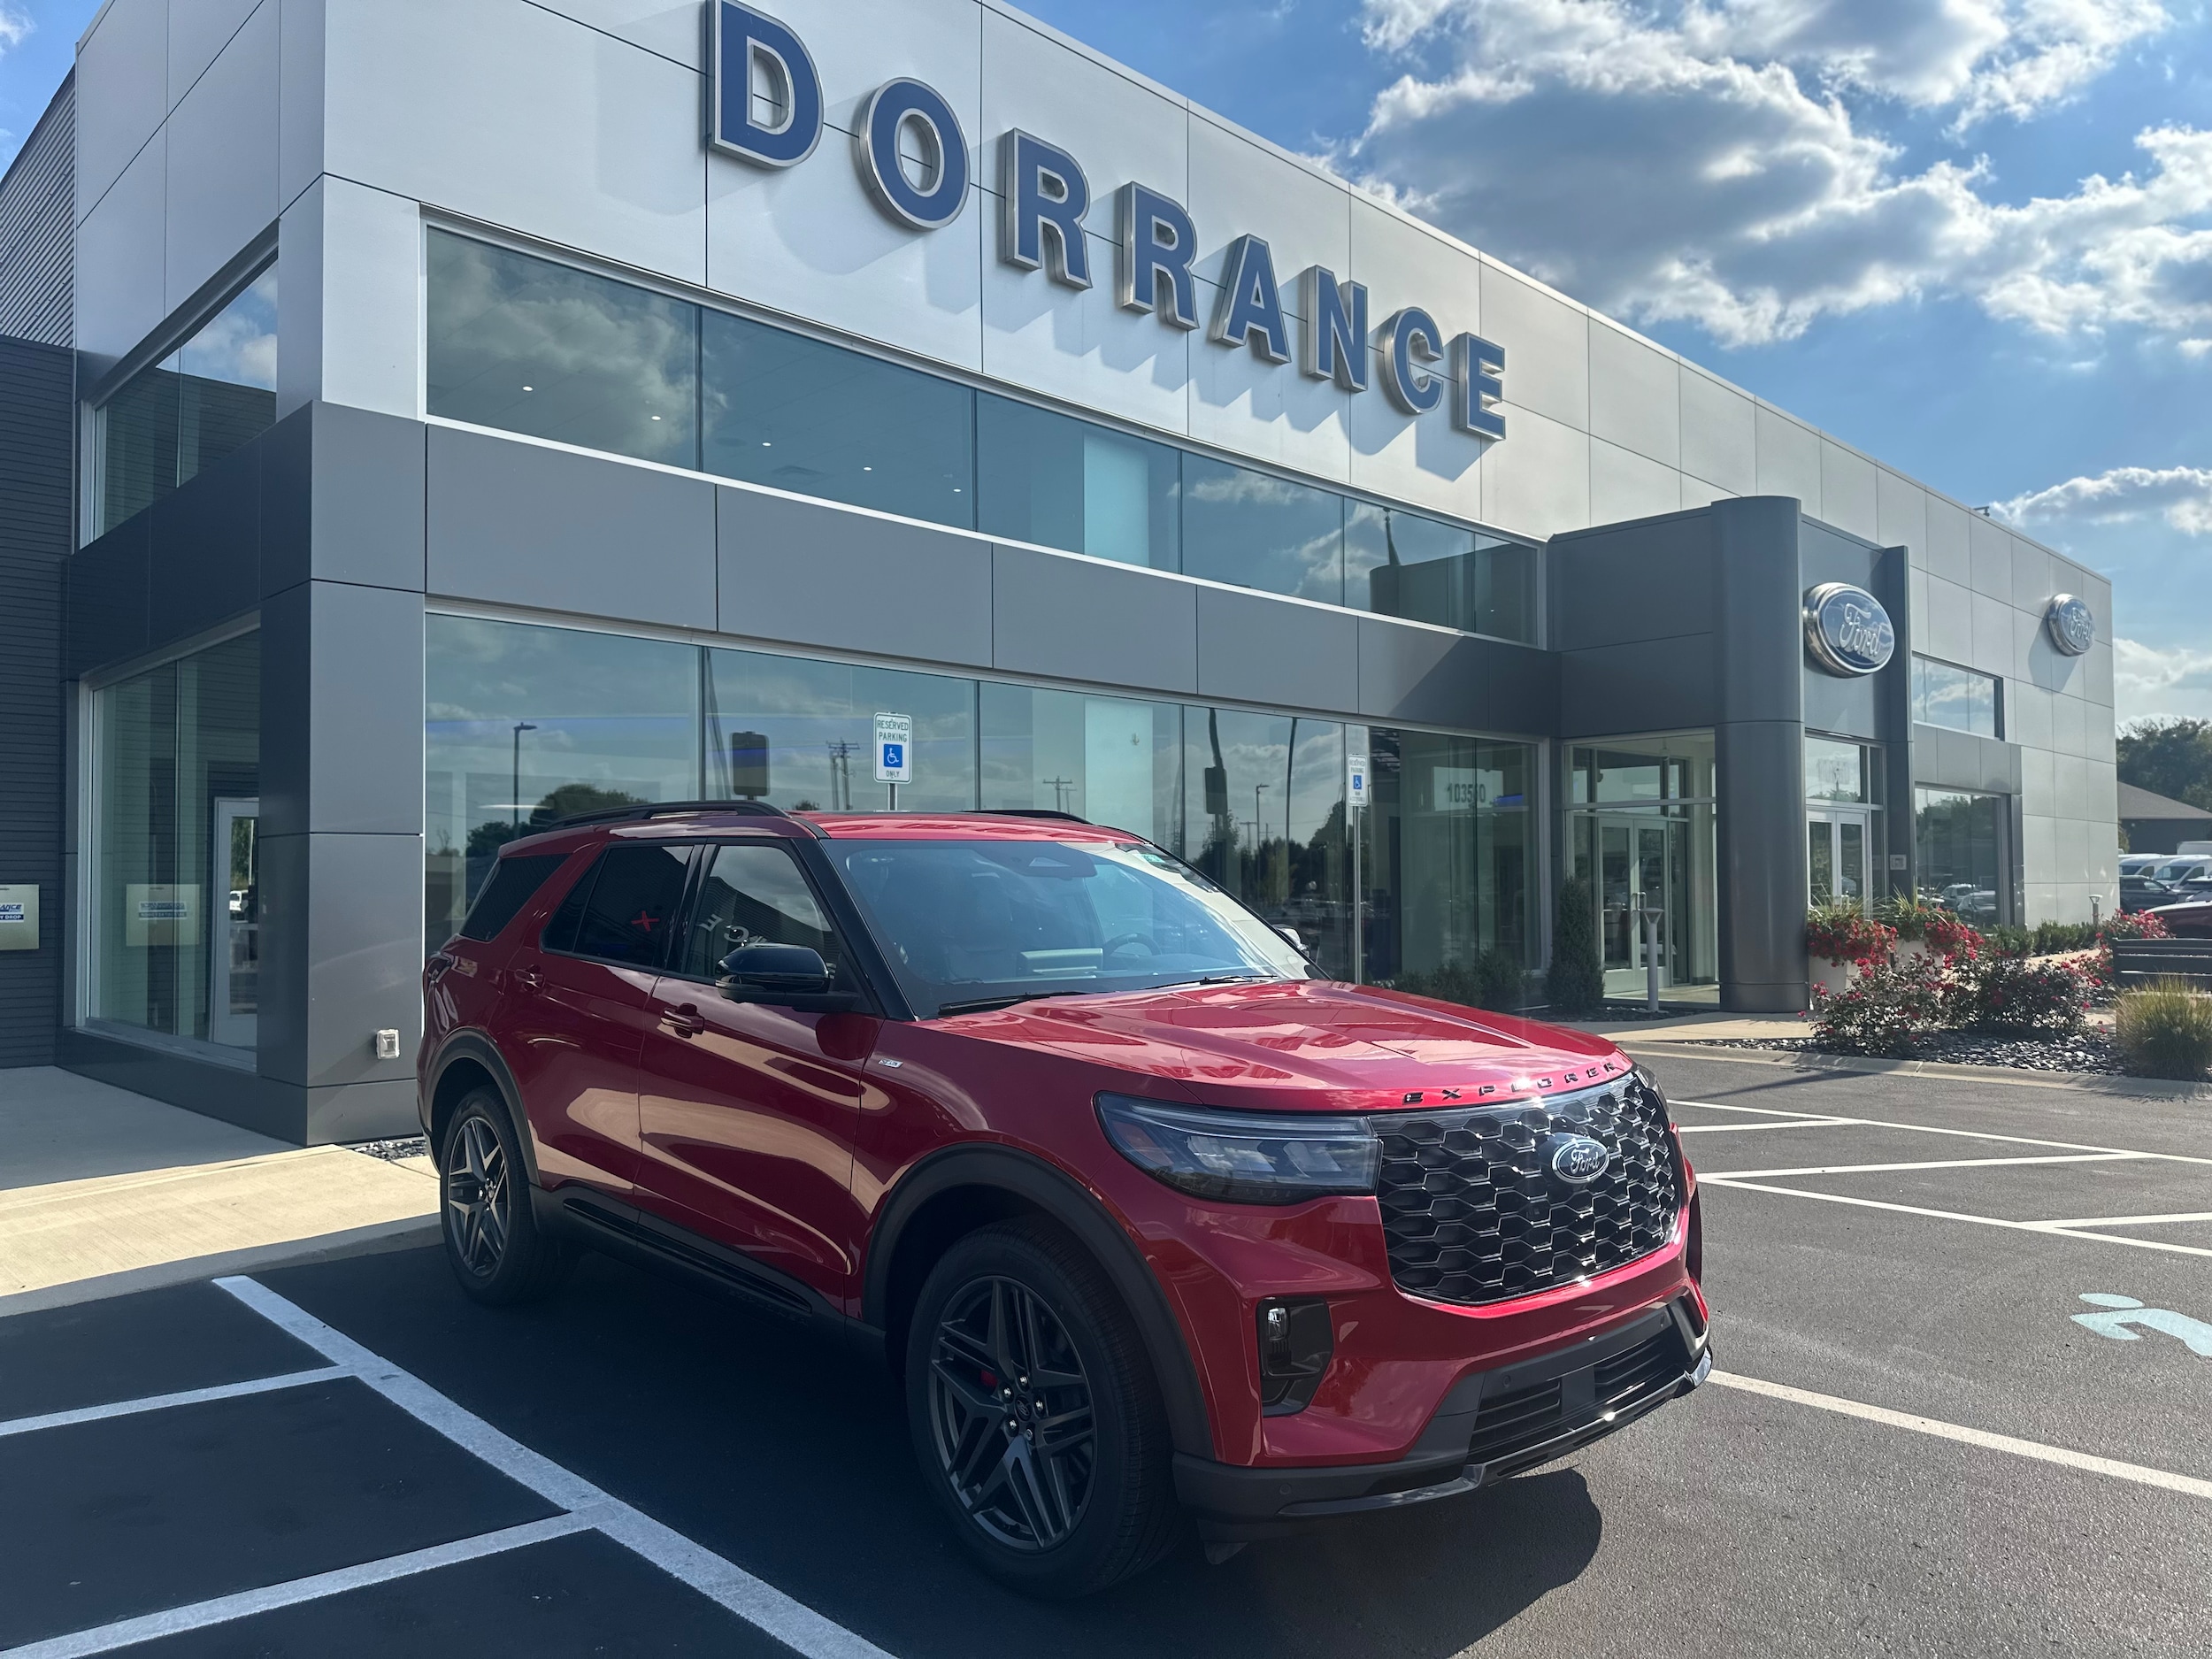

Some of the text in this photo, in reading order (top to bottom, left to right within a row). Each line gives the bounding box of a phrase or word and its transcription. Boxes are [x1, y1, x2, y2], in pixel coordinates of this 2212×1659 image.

[708, 0, 1506, 442] DORRANCE
[1838, 603, 1884, 657] Ford
[2069, 607, 2093, 642] Ford
[877, 719, 909, 731] RESERVED
[879, 732, 907, 742] PARKING
[1402, 1062, 1617, 1104] EXPLORER
[1570, 1148, 1600, 1174] Ford
